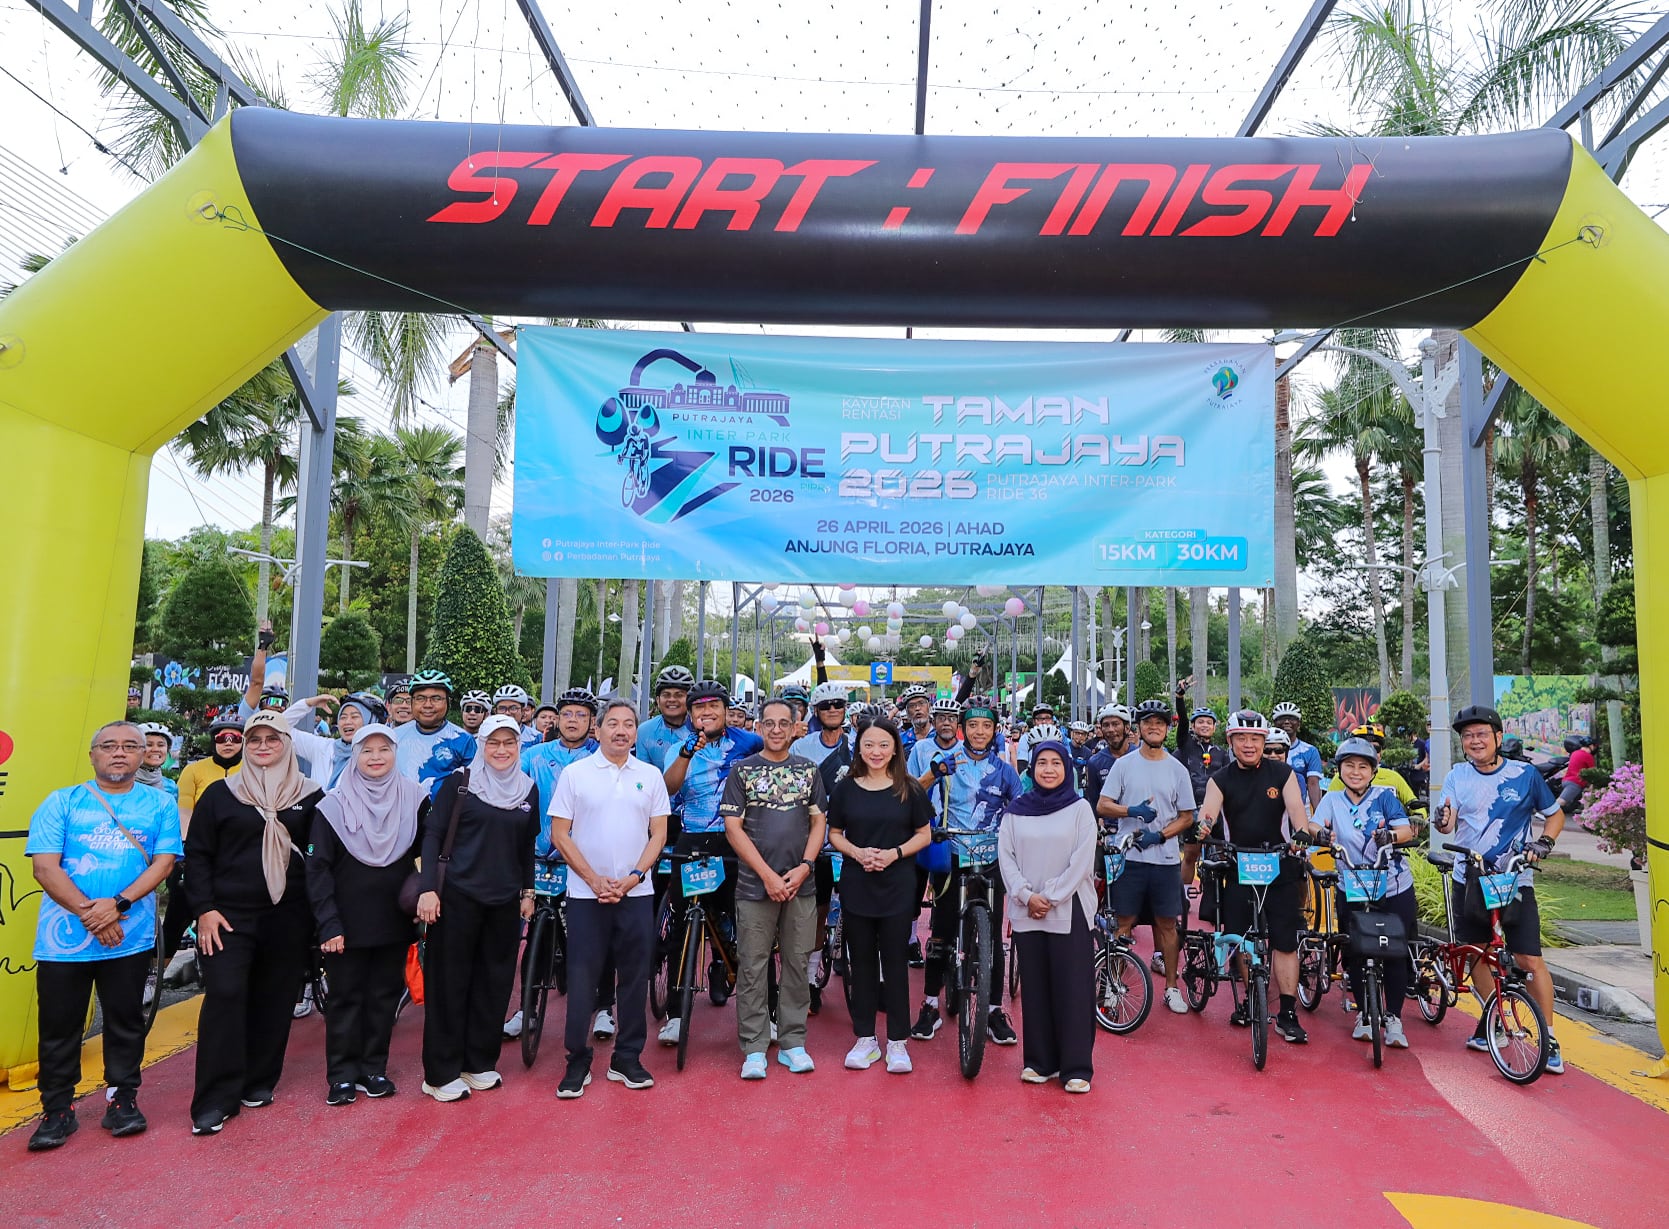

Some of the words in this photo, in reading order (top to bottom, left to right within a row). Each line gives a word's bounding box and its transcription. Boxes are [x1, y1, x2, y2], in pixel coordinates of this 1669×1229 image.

[426, 150, 880, 231] START
[955, 163, 1374, 237] FINISH
[842, 398, 911, 409] KAYUHAN
[842, 408, 901, 421] RENTASI
[922, 394, 1109, 428] TAMAN
[672, 413, 753, 424] PUTRAJAYA
[687, 430, 737, 441] INTER
[745, 431, 792, 442] PARK
[841, 431, 1186, 470] PUTRAJAYA
[728, 446, 826, 478] RIDE
[838, 468, 978, 500] 2026
[987, 474, 1079, 487] PUTRAJAYA
[1083, 475, 1177, 489] INTER-PARK
[750, 489, 794, 503] 2026
[987, 487, 1024, 500] RIDE
[1031, 489, 1048, 500] 36
[816, 520, 839, 533] 26
[843, 520, 895, 534] APRIL
[899, 521, 943, 535] 2026
[955, 522, 1005, 535] AHAD
[1144, 530, 1197, 539] KATEGORI
[555, 540, 595, 550] Putrajaya
[641, 541, 661, 549] Ride
[785, 540, 859, 554] ANJUNG
[863, 541, 930, 557] FLORIA,
[935, 542, 1035, 556] PUTRAJAYA
[567, 552, 618, 561] Perbadanan
[1099, 544, 1156, 561] 15KM
[1177, 544, 1238, 561] 30KM
[208, 671, 251, 693] FLORIA
[1245, 864, 1273, 872] 1501
